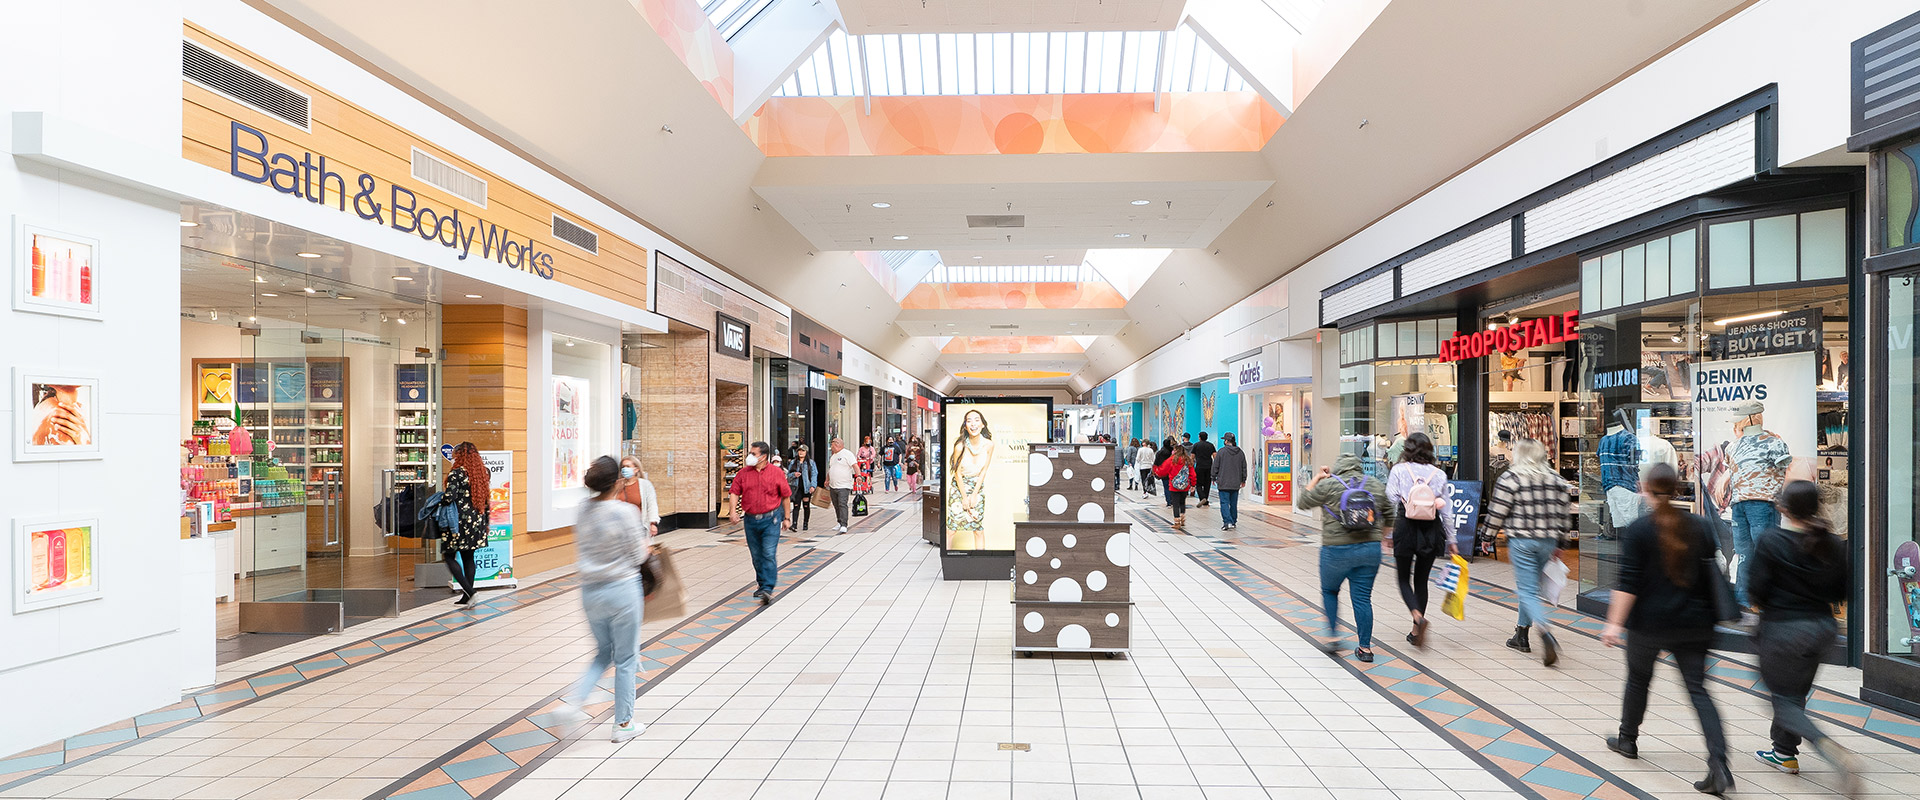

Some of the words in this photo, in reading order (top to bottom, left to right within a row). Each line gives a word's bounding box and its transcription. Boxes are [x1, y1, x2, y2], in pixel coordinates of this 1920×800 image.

[230, 120, 346, 212] Bath
[352, 173, 384, 225] &
[391, 184, 476, 261] Body
[478, 218, 555, 281] Works
[1728, 324, 1757, 336] JEANS
[1758, 322, 1766, 332] &
[1766, 317, 1807, 330] SHORTS
[722, 321, 744, 352] VANS
[1438, 309, 1580, 364] AÉROPOSTALE
[1728, 336, 1759, 353] BUY
[1761, 335, 1769, 349] 1
[1772, 330, 1806, 348] GET
[1808, 329, 1817, 344] 1
[1239, 361, 1261, 385] claire's
[1696, 366, 1753, 386] DENIM
[1695, 384, 1768, 402] ALWAYS
[1428, 423, 1445, 435] NYC
[1269, 459, 1290, 467] FREE
[1271, 482, 1284, 495] $2
[488, 529, 506, 537] OVE
[475, 558, 498, 569] REE
